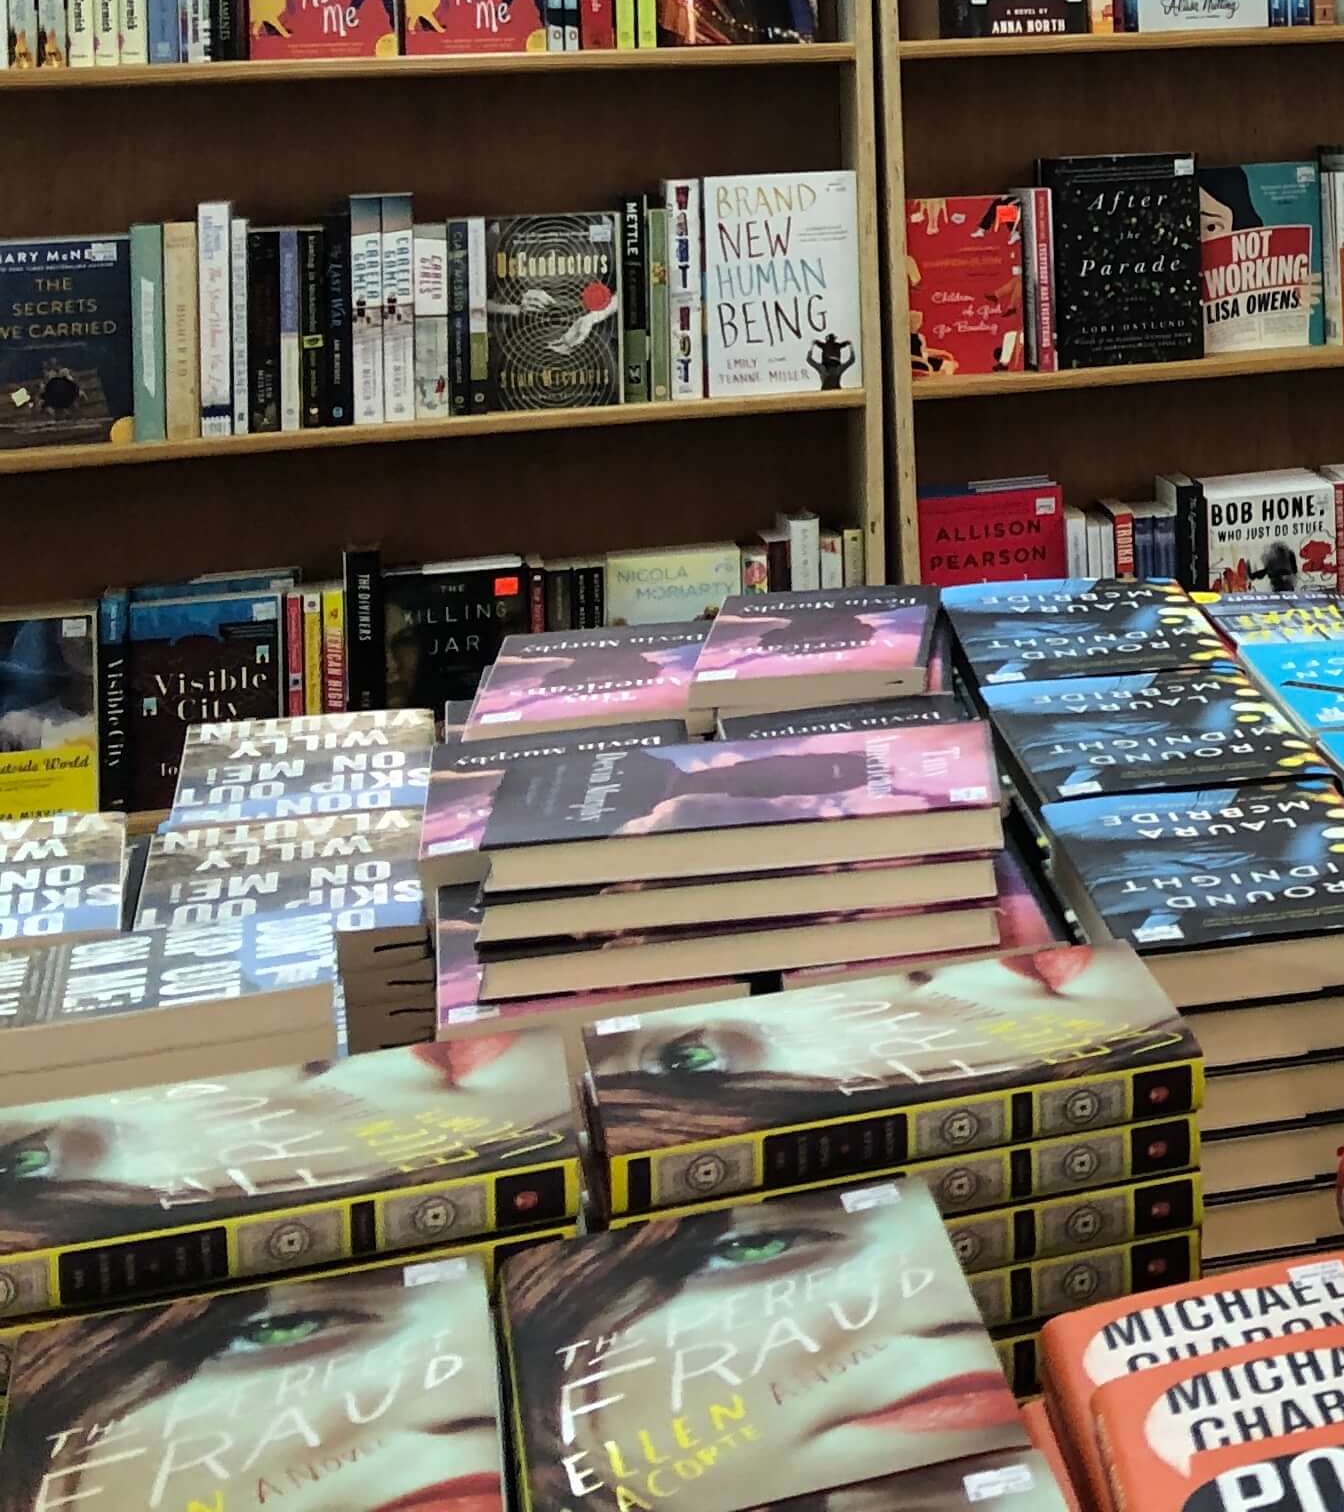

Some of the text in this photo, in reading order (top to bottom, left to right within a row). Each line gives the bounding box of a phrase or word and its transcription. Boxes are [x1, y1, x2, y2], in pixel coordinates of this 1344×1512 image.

[322, 6, 359, 37] Me
[992, 19, 1065, 33] ANNA NORTH
[716, 182, 816, 218] BRAND
[1087, 190, 1168, 212] After
[626, 202, 638, 257] METTLE
[718, 216, 792, 262] NEW
[1232, 230, 1272, 262] NOT
[715, 258, 827, 300] HUMAN
[1080, 258, 1182, 278] Parade
[1205, 253, 1309, 297] WORKING
[35, 278, 72, 292] THE
[12, 297, 97, 316] SECRETS
[1206, 289, 1298, 324] LISA OWENS
[29, 320, 117, 339] CARRIED
[718, 294, 827, 349] BEING
[1211, 502, 1254, 526] BOB
[935, 519, 1041, 543] ALLISON
[1218, 527, 1271, 542] WHO JUST
[930, 546, 1048, 571] PEARSON
[617, 567, 688, 584] NICOLA
[636, 582, 733, 600] MORIARTY
[403, 602, 507, 625] KILLING
[428, 635, 481, 655] JAR
[155, 667, 268, 697] Visible
[177, 697, 237, 722] City
[228, 729, 389, 759] WILLY
[206, 760, 305, 785] ME!
[333, 751, 406, 772] ON
[310, 768, 431, 793] SKIP
[179, 781, 285, 806] OUT
[1103, 800, 1309, 828] McBRIDE
[1141, 815, 1296, 840] LAURA
